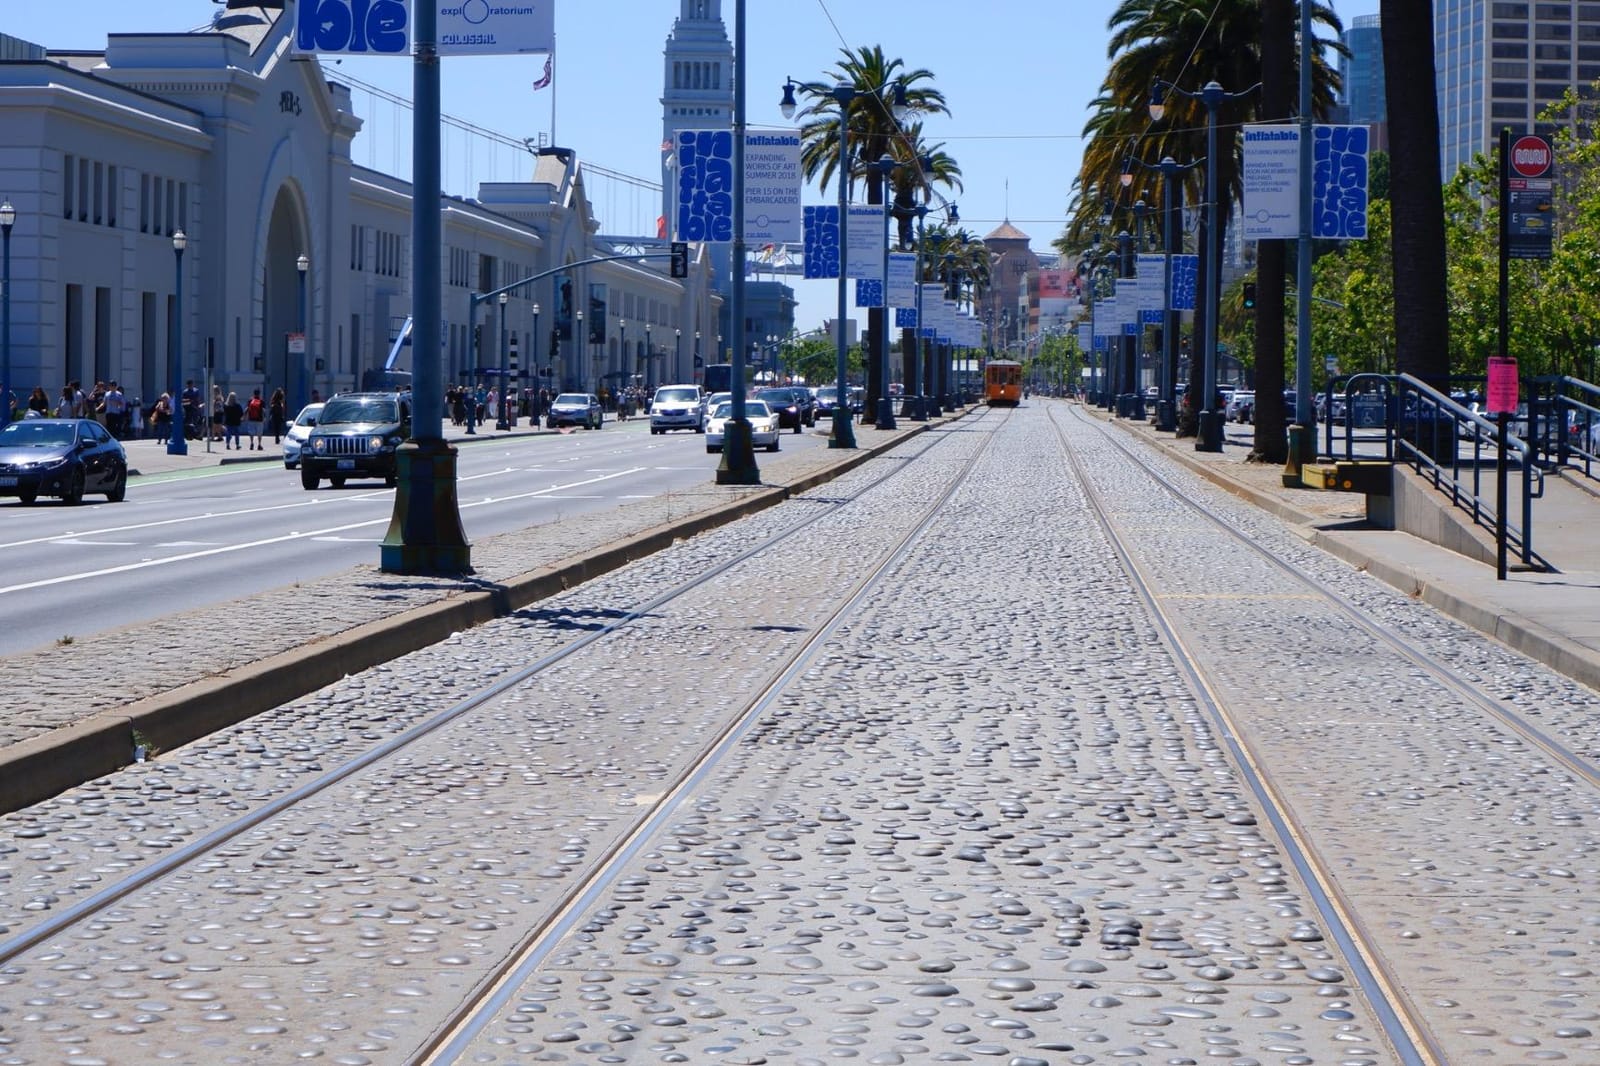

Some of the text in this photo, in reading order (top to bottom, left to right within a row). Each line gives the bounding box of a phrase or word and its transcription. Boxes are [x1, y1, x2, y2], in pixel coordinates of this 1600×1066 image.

[1245, 131, 1299, 141] inflatable
[746, 136, 800, 146] inflatable
[745, 163, 796, 171] WORKS OF ART
[745, 171, 777, 179] SUMMER
[785, 187, 799, 195] THE
[745, 196, 799, 204] EMBARCADERO
[1510, 192, 1519, 203] F
